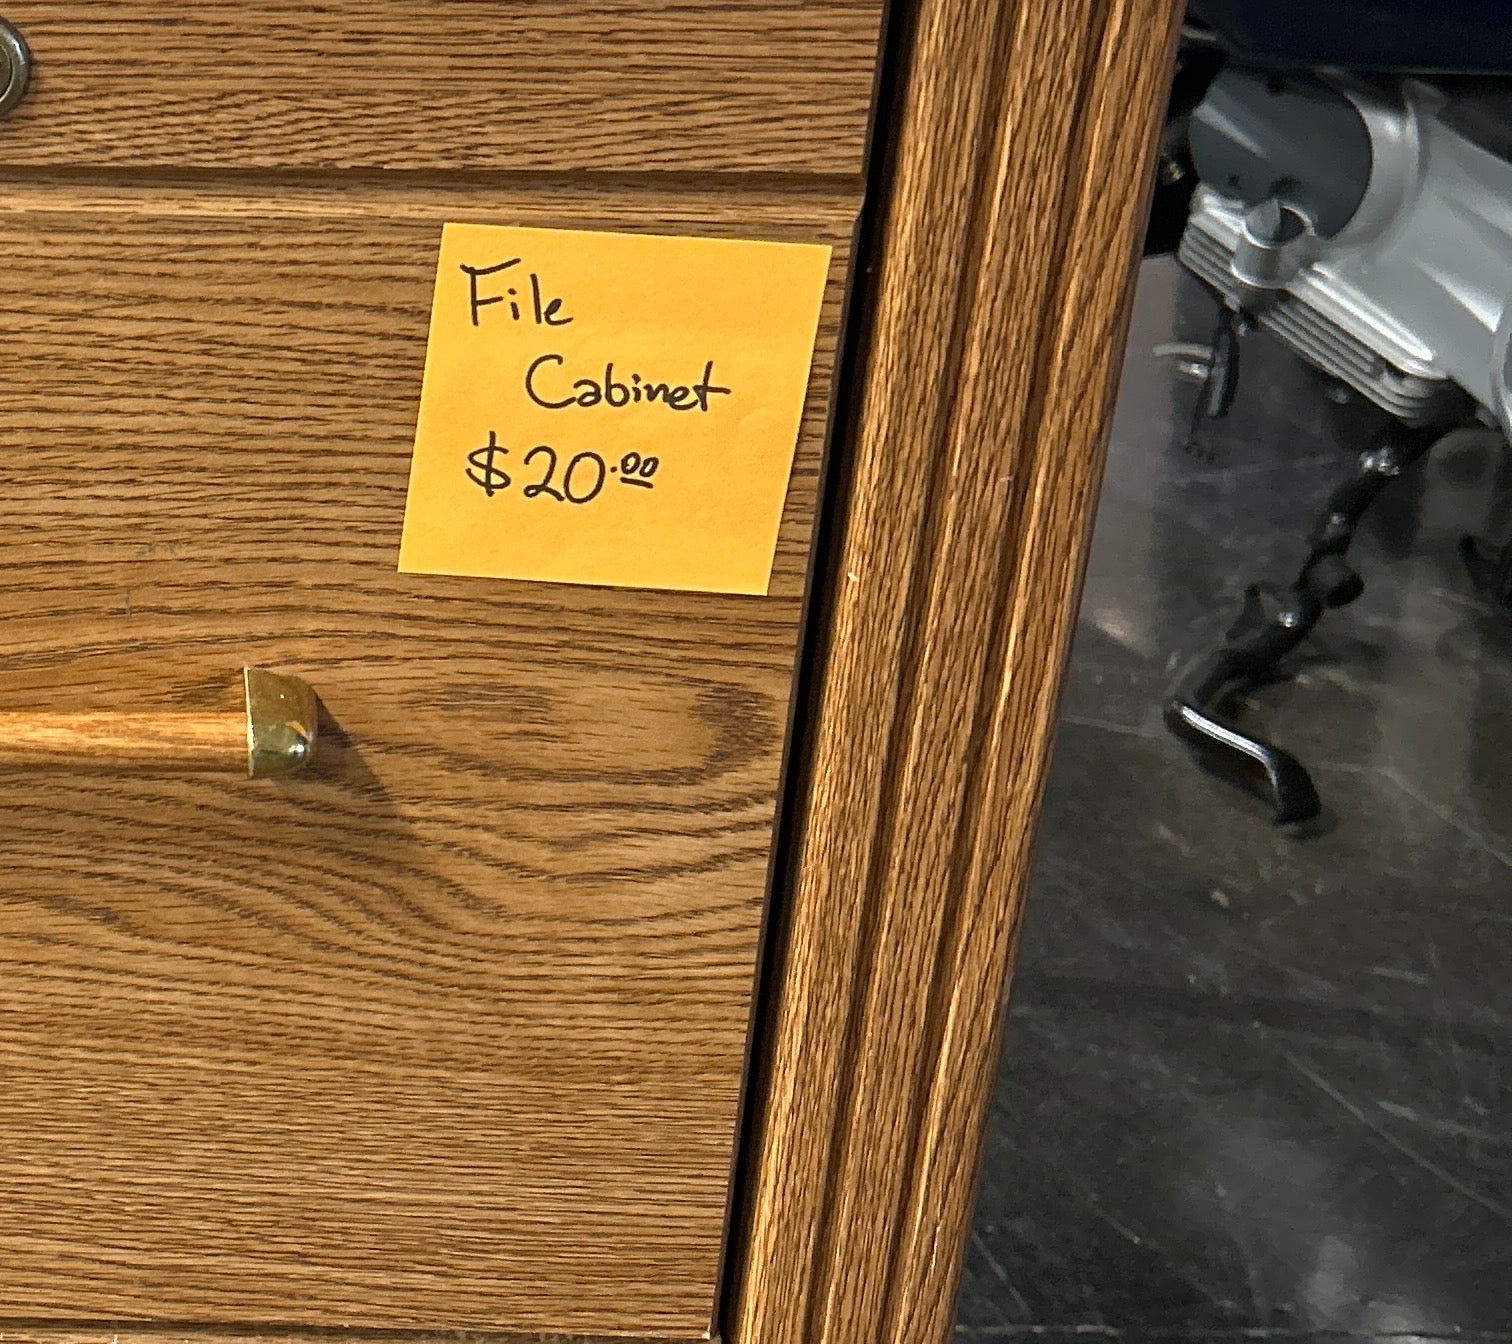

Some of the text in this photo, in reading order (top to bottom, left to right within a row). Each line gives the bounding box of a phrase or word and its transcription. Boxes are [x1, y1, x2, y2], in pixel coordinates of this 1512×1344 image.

[460, 257, 574, 327] File
[525, 354, 732, 412] Cabinet
[465, 430, 660, 504] $20.00
